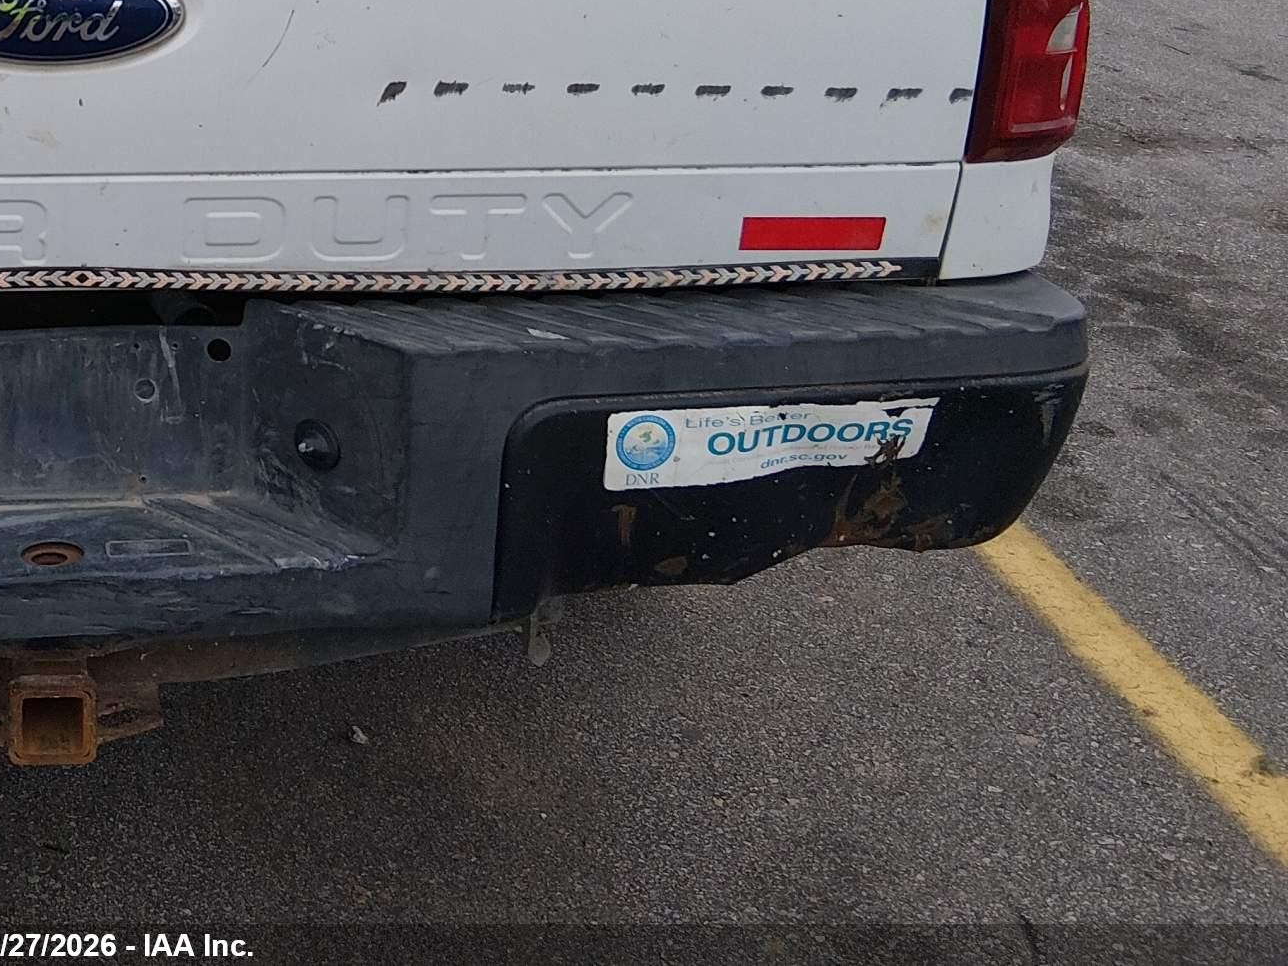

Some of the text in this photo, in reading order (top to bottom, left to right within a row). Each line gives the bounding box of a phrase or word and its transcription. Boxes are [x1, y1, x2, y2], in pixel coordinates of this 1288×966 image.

[182, 191, 634, 264] DUTY
[707, 418, 914, 456] OUTDOORS
[759, 453, 848, 470] dnr.sc.gov
[625, 472, 660, 486] DNR
